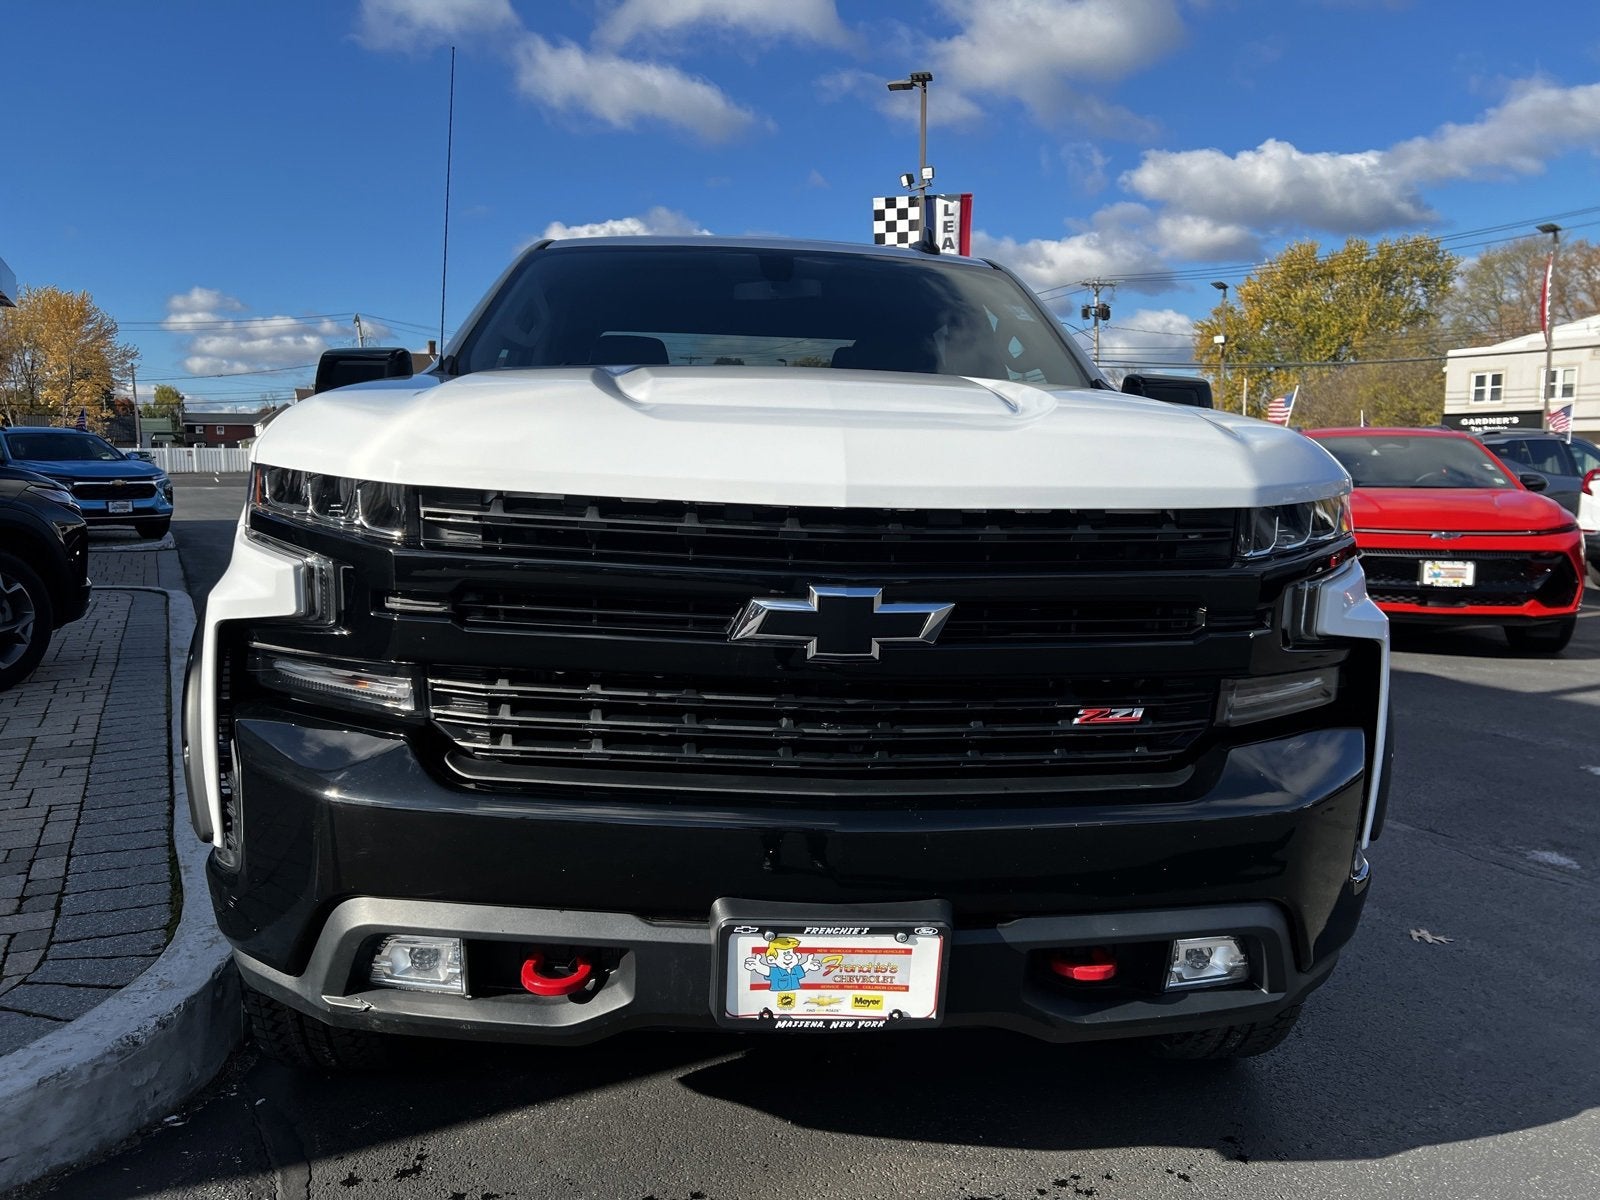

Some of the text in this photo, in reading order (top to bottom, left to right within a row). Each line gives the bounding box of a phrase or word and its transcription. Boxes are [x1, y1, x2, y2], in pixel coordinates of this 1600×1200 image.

[1460, 417, 1520, 425] GARDNER'S
[1072, 708, 1145, 724] Z71
[804, 927, 869, 935] FRENCHIE'S
[832, 975, 895, 984] CHEVROLET
[829, 1020, 855, 1029] NEW
[857, 1020, 886, 1029] YORK
